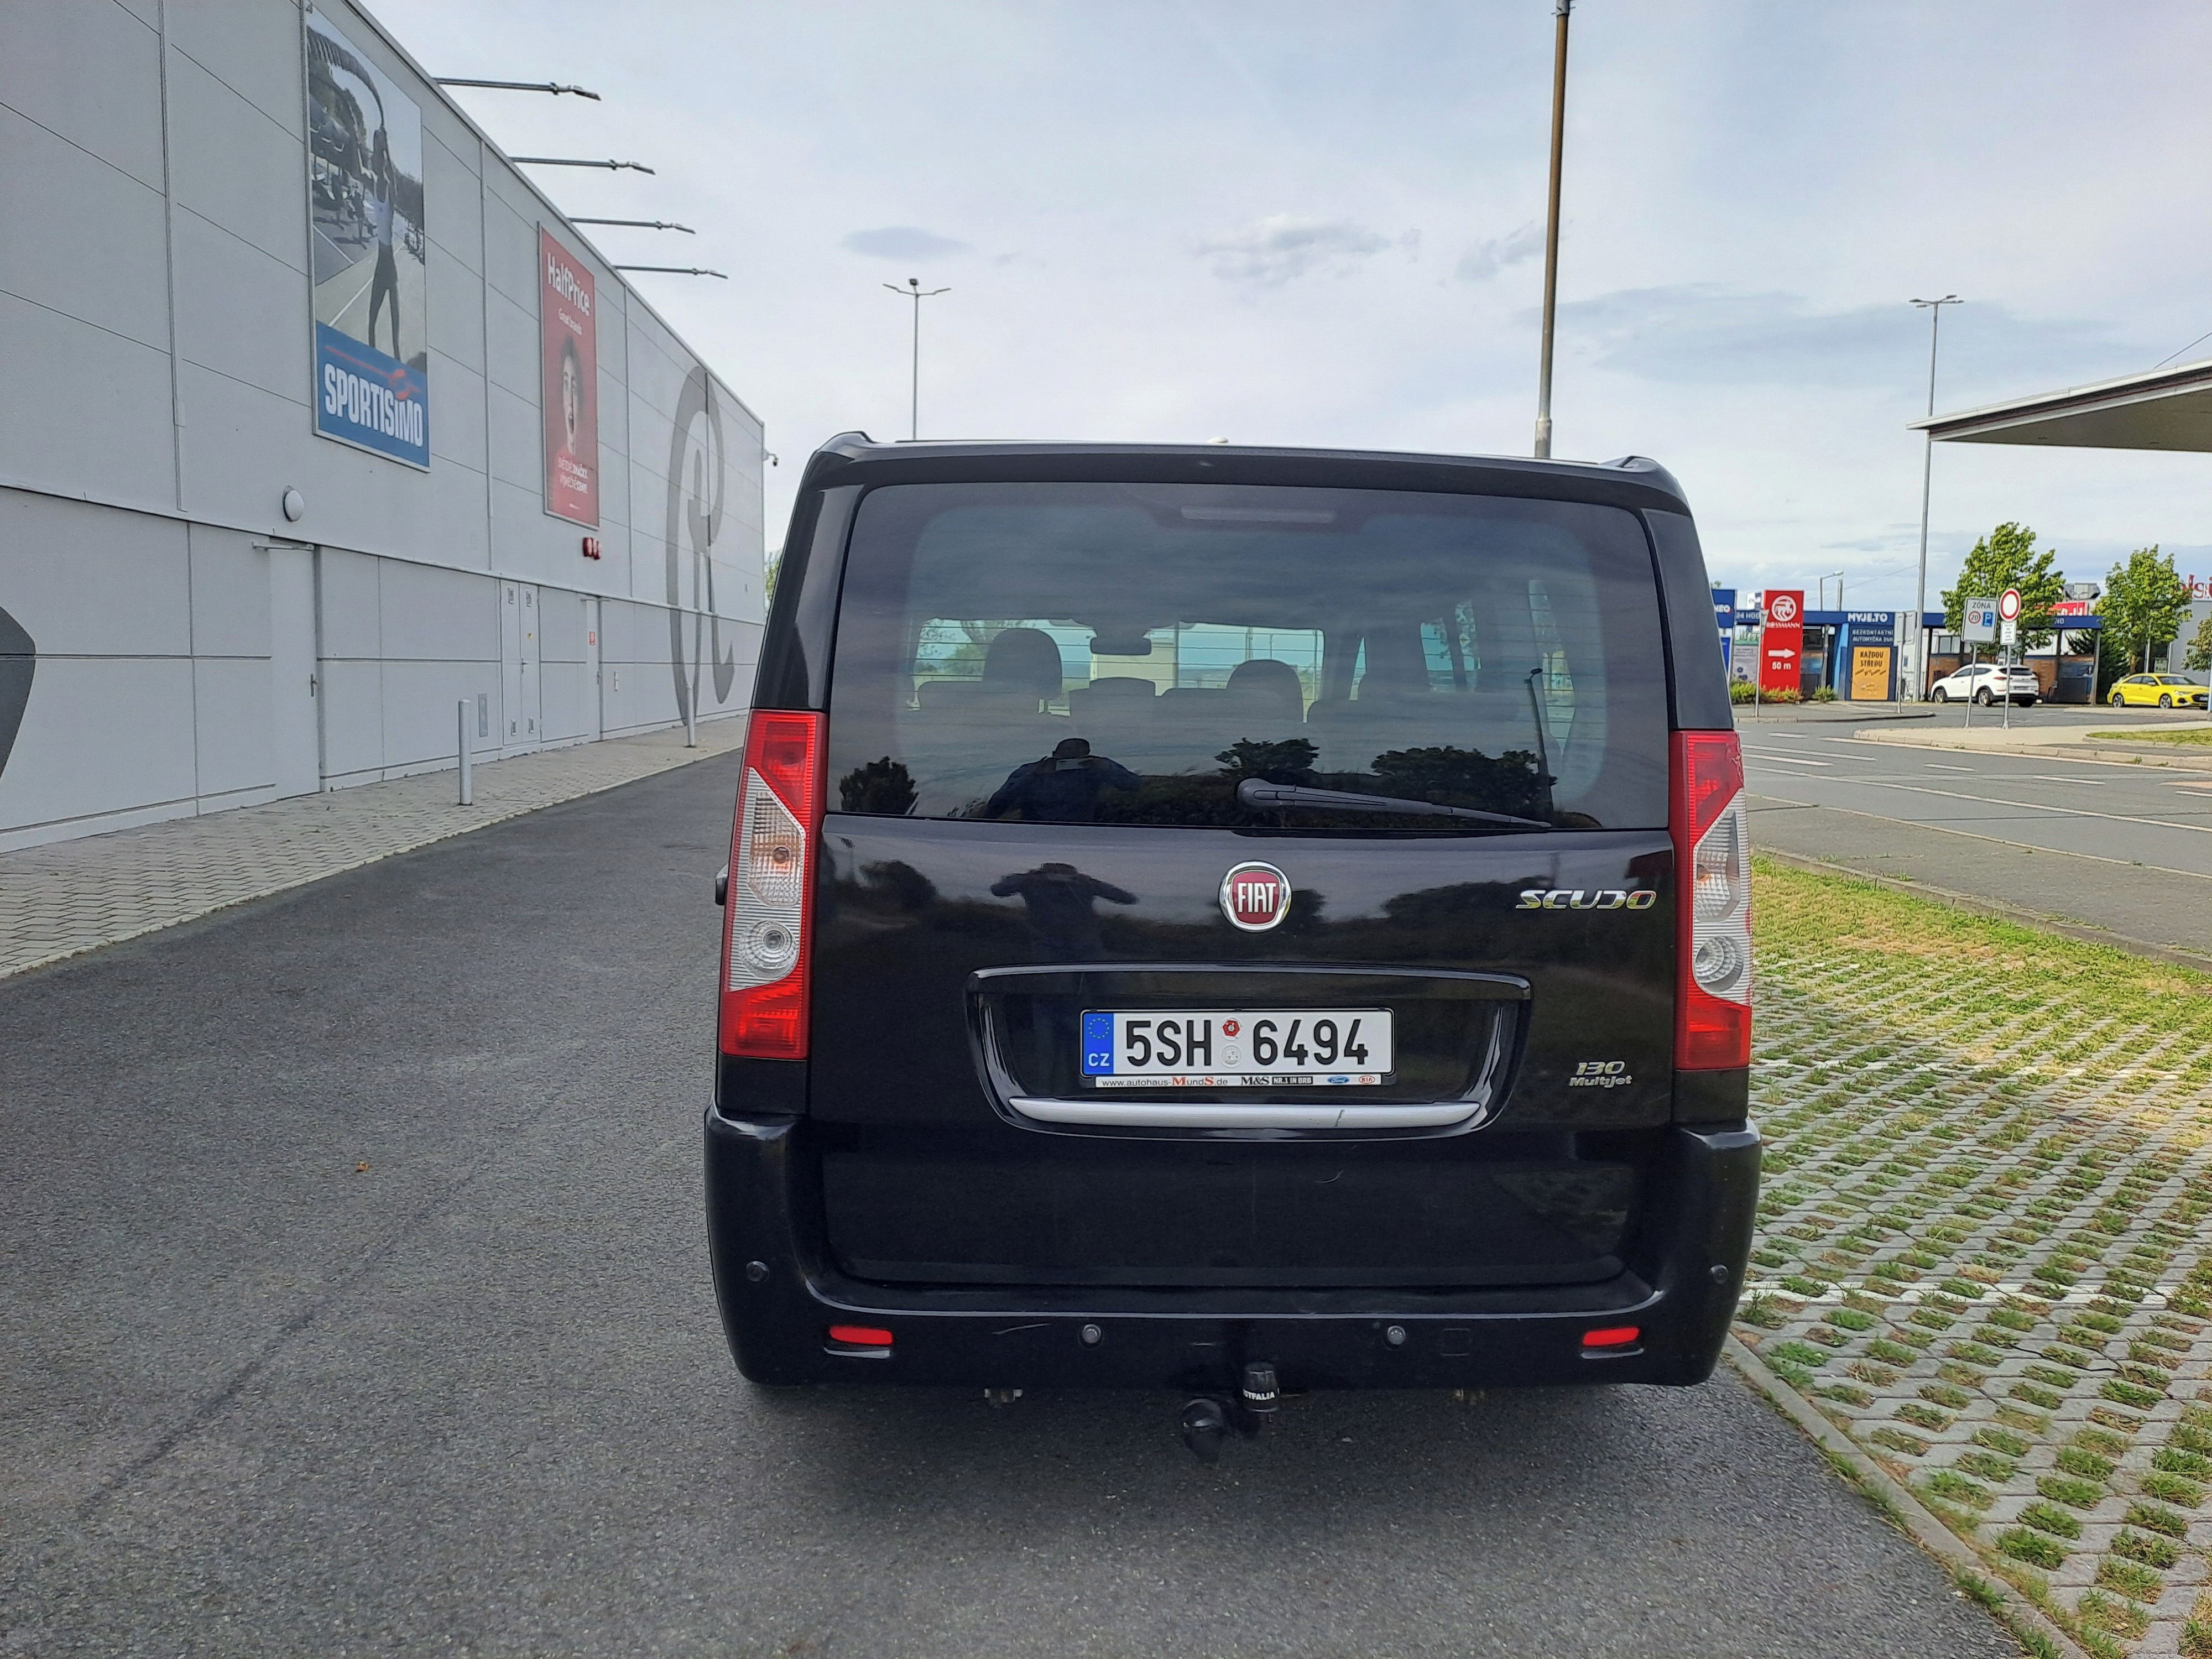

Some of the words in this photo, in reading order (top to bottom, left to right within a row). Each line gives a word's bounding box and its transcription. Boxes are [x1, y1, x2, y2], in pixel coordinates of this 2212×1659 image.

[547, 252, 590, 317] HalfPrice
[324, 362, 424, 448] SPORTISIMO
[1238, 882, 1277, 913] FIAT
[1515, 890, 1657, 910] SCUDO
[1126, 1019, 1212, 1067] 5SH
[1252, 1019, 1368, 1066] 6494
[1088, 1053, 1110, 1067] CZ
[1576, 1061, 1625, 1075] 130
[1102, 1076, 1228, 1087] www.autohaus-MundS.de
[1241, 1076, 1270, 1085] M&S
